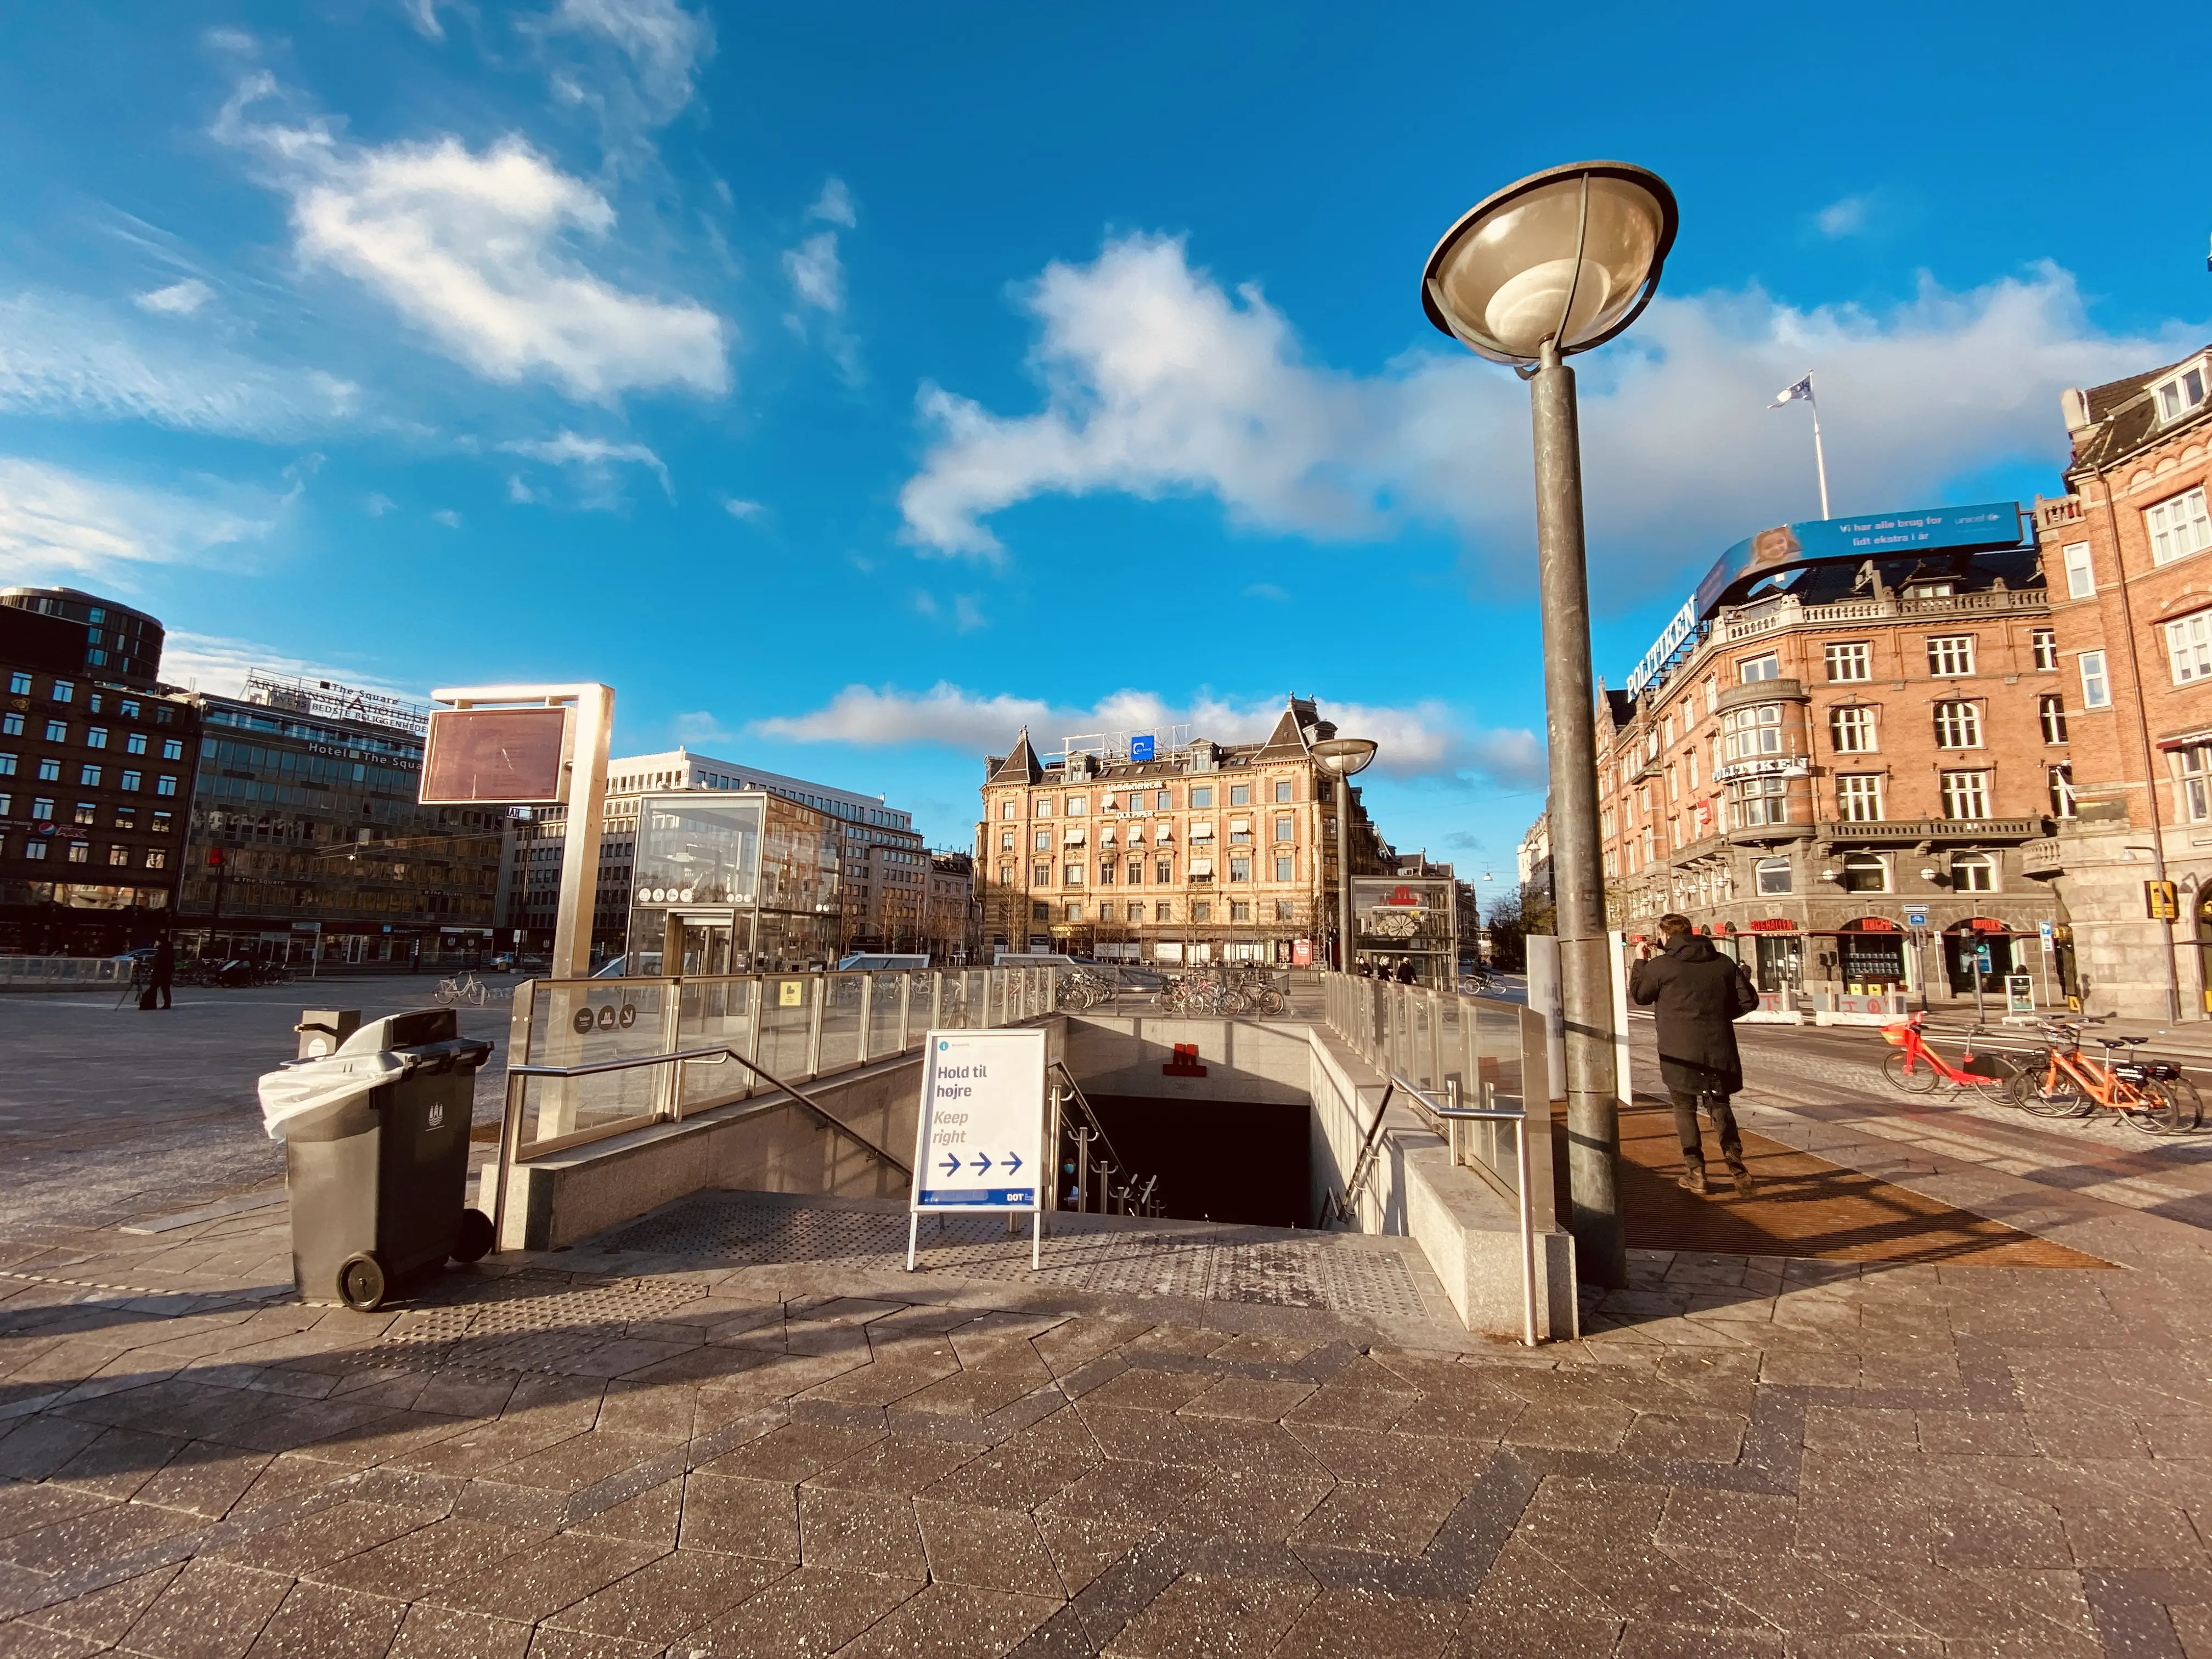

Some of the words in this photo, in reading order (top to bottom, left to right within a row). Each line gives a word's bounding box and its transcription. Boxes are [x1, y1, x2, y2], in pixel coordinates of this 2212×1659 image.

[1839, 523, 1852, 533] Vi
[1854, 522, 1872, 531] har
[1875, 520, 1895, 529] alle
[1898, 517, 1923, 527] brug
[1926, 516, 1943, 524] for
[1853, 537, 1871, 546] lidt
[1874, 534, 1909, 544] ekstra
[1627, 594, 1697, 703] POLITIKEN
[332, 683, 354, 695] The
[359, 690, 399, 706] Square
[312, 703, 351, 718] BEDSTE
[355, 712, 428, 733] BELIGGENHEDE
[309, 742, 347, 757] Hotel
[363, 752, 387, 764] The
[1107, 780, 1163, 792] klasselotteriet.dk
[1132, 810, 1154, 818] PIPER
[938, 1066, 969, 1079] Hold
[973, 1064, 988, 1078] til
[936, 1084, 972, 1100] højre
[934, 1111, 969, 1126] Keep
[932, 1129, 967, 1147] right
[1007, 1193, 1024, 1202] DOT
